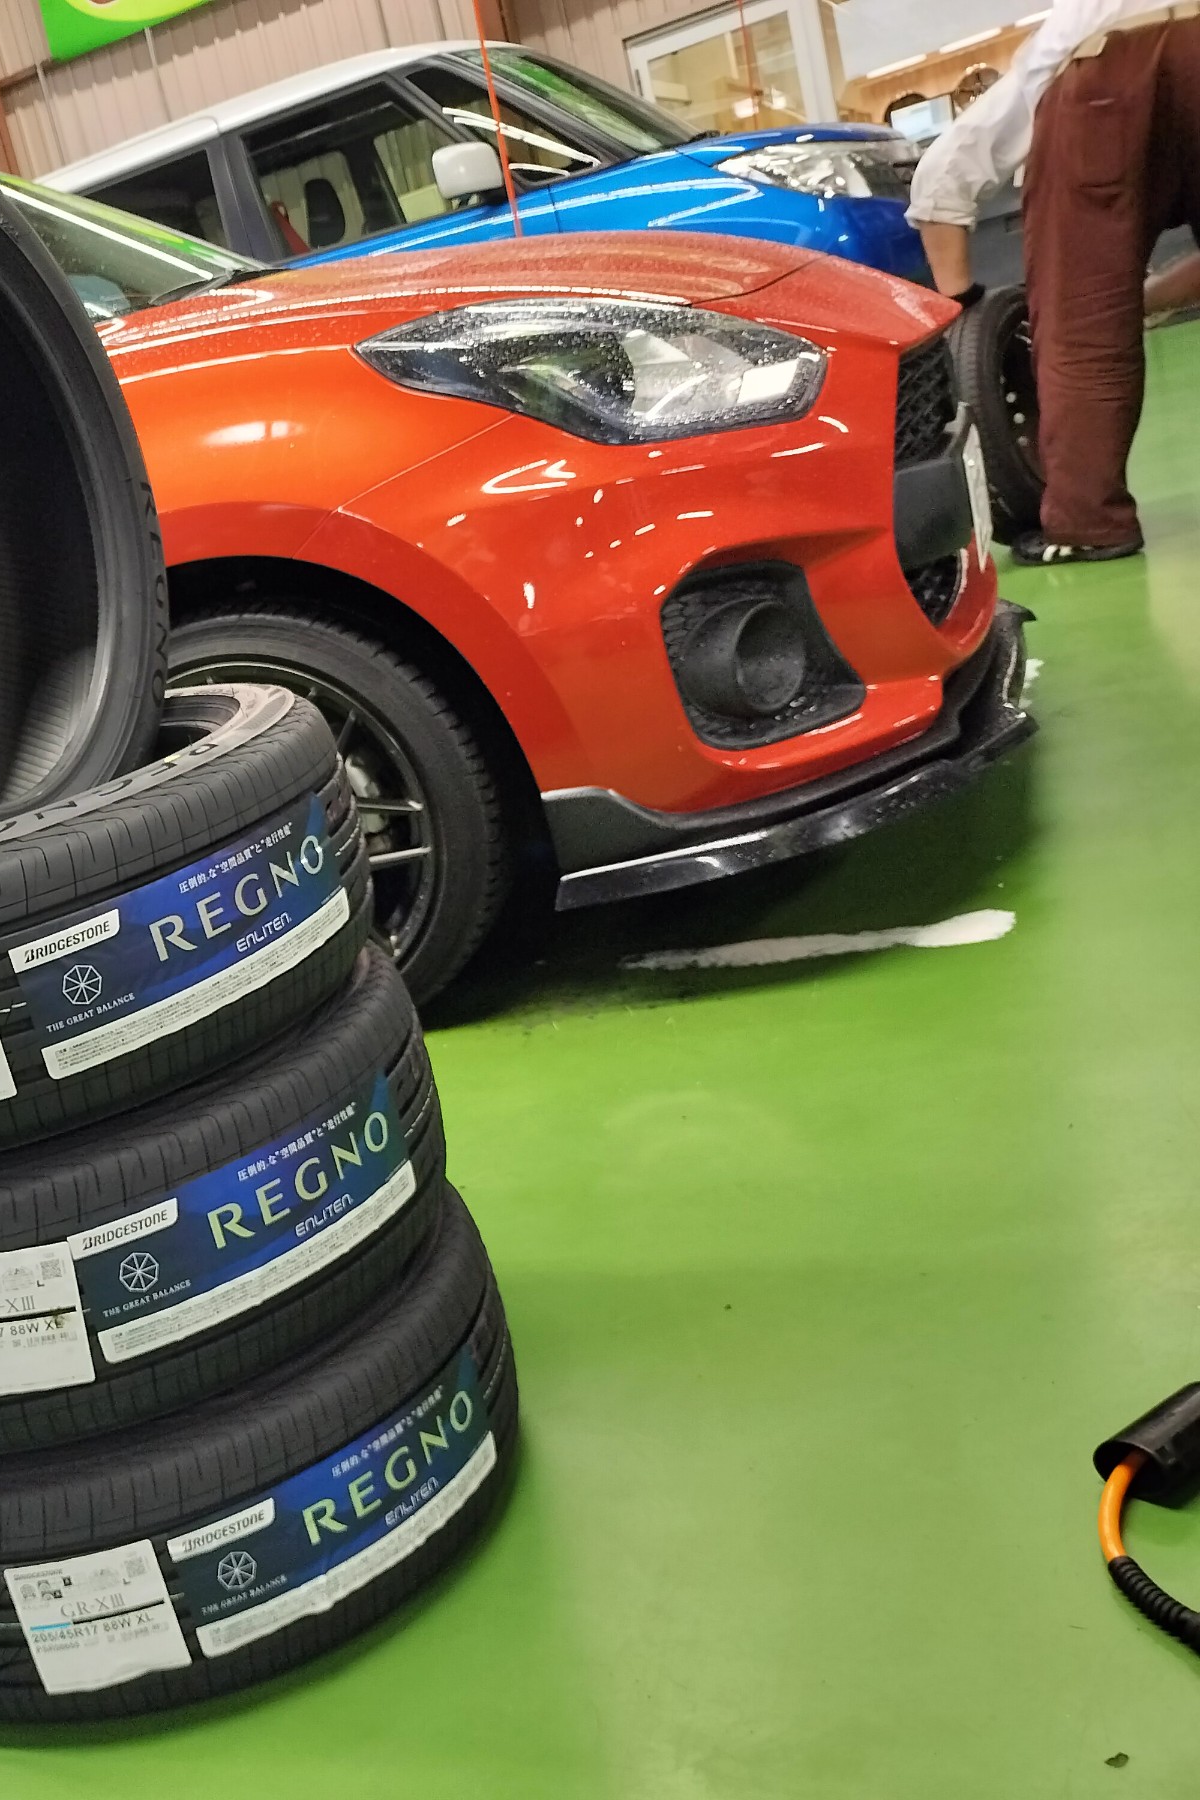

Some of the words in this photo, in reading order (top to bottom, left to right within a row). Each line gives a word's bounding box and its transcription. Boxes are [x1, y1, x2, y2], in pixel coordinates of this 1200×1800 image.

[149, 835, 324, 962] REGNO
[24, 920, 110, 964] BRIDGESTONE
[236, 912, 291, 953] ENLITEN
[46, 1020, 65, 1033] THE
[66, 1009, 95, 1026] GREAT
[96, 992, 136, 1015] BALANCE
[207, 1111, 388, 1250] REGNO
[82, 1209, 168, 1251] BRIDGESTONE
[295, 1193, 352, 1238] ENLITEN
[103, 1306, 120, 1318] THE
[122, 1296, 151, 1311] GREAT
[152, 1279, 192, 1300] BALANCE
[10, 1323, 40, 1336] 88W
[302, 1390, 473, 1546] REGNO
[182, 1509, 265, 1553] BRIDGESTONE
[137, 1613, 155, 1626] XL
